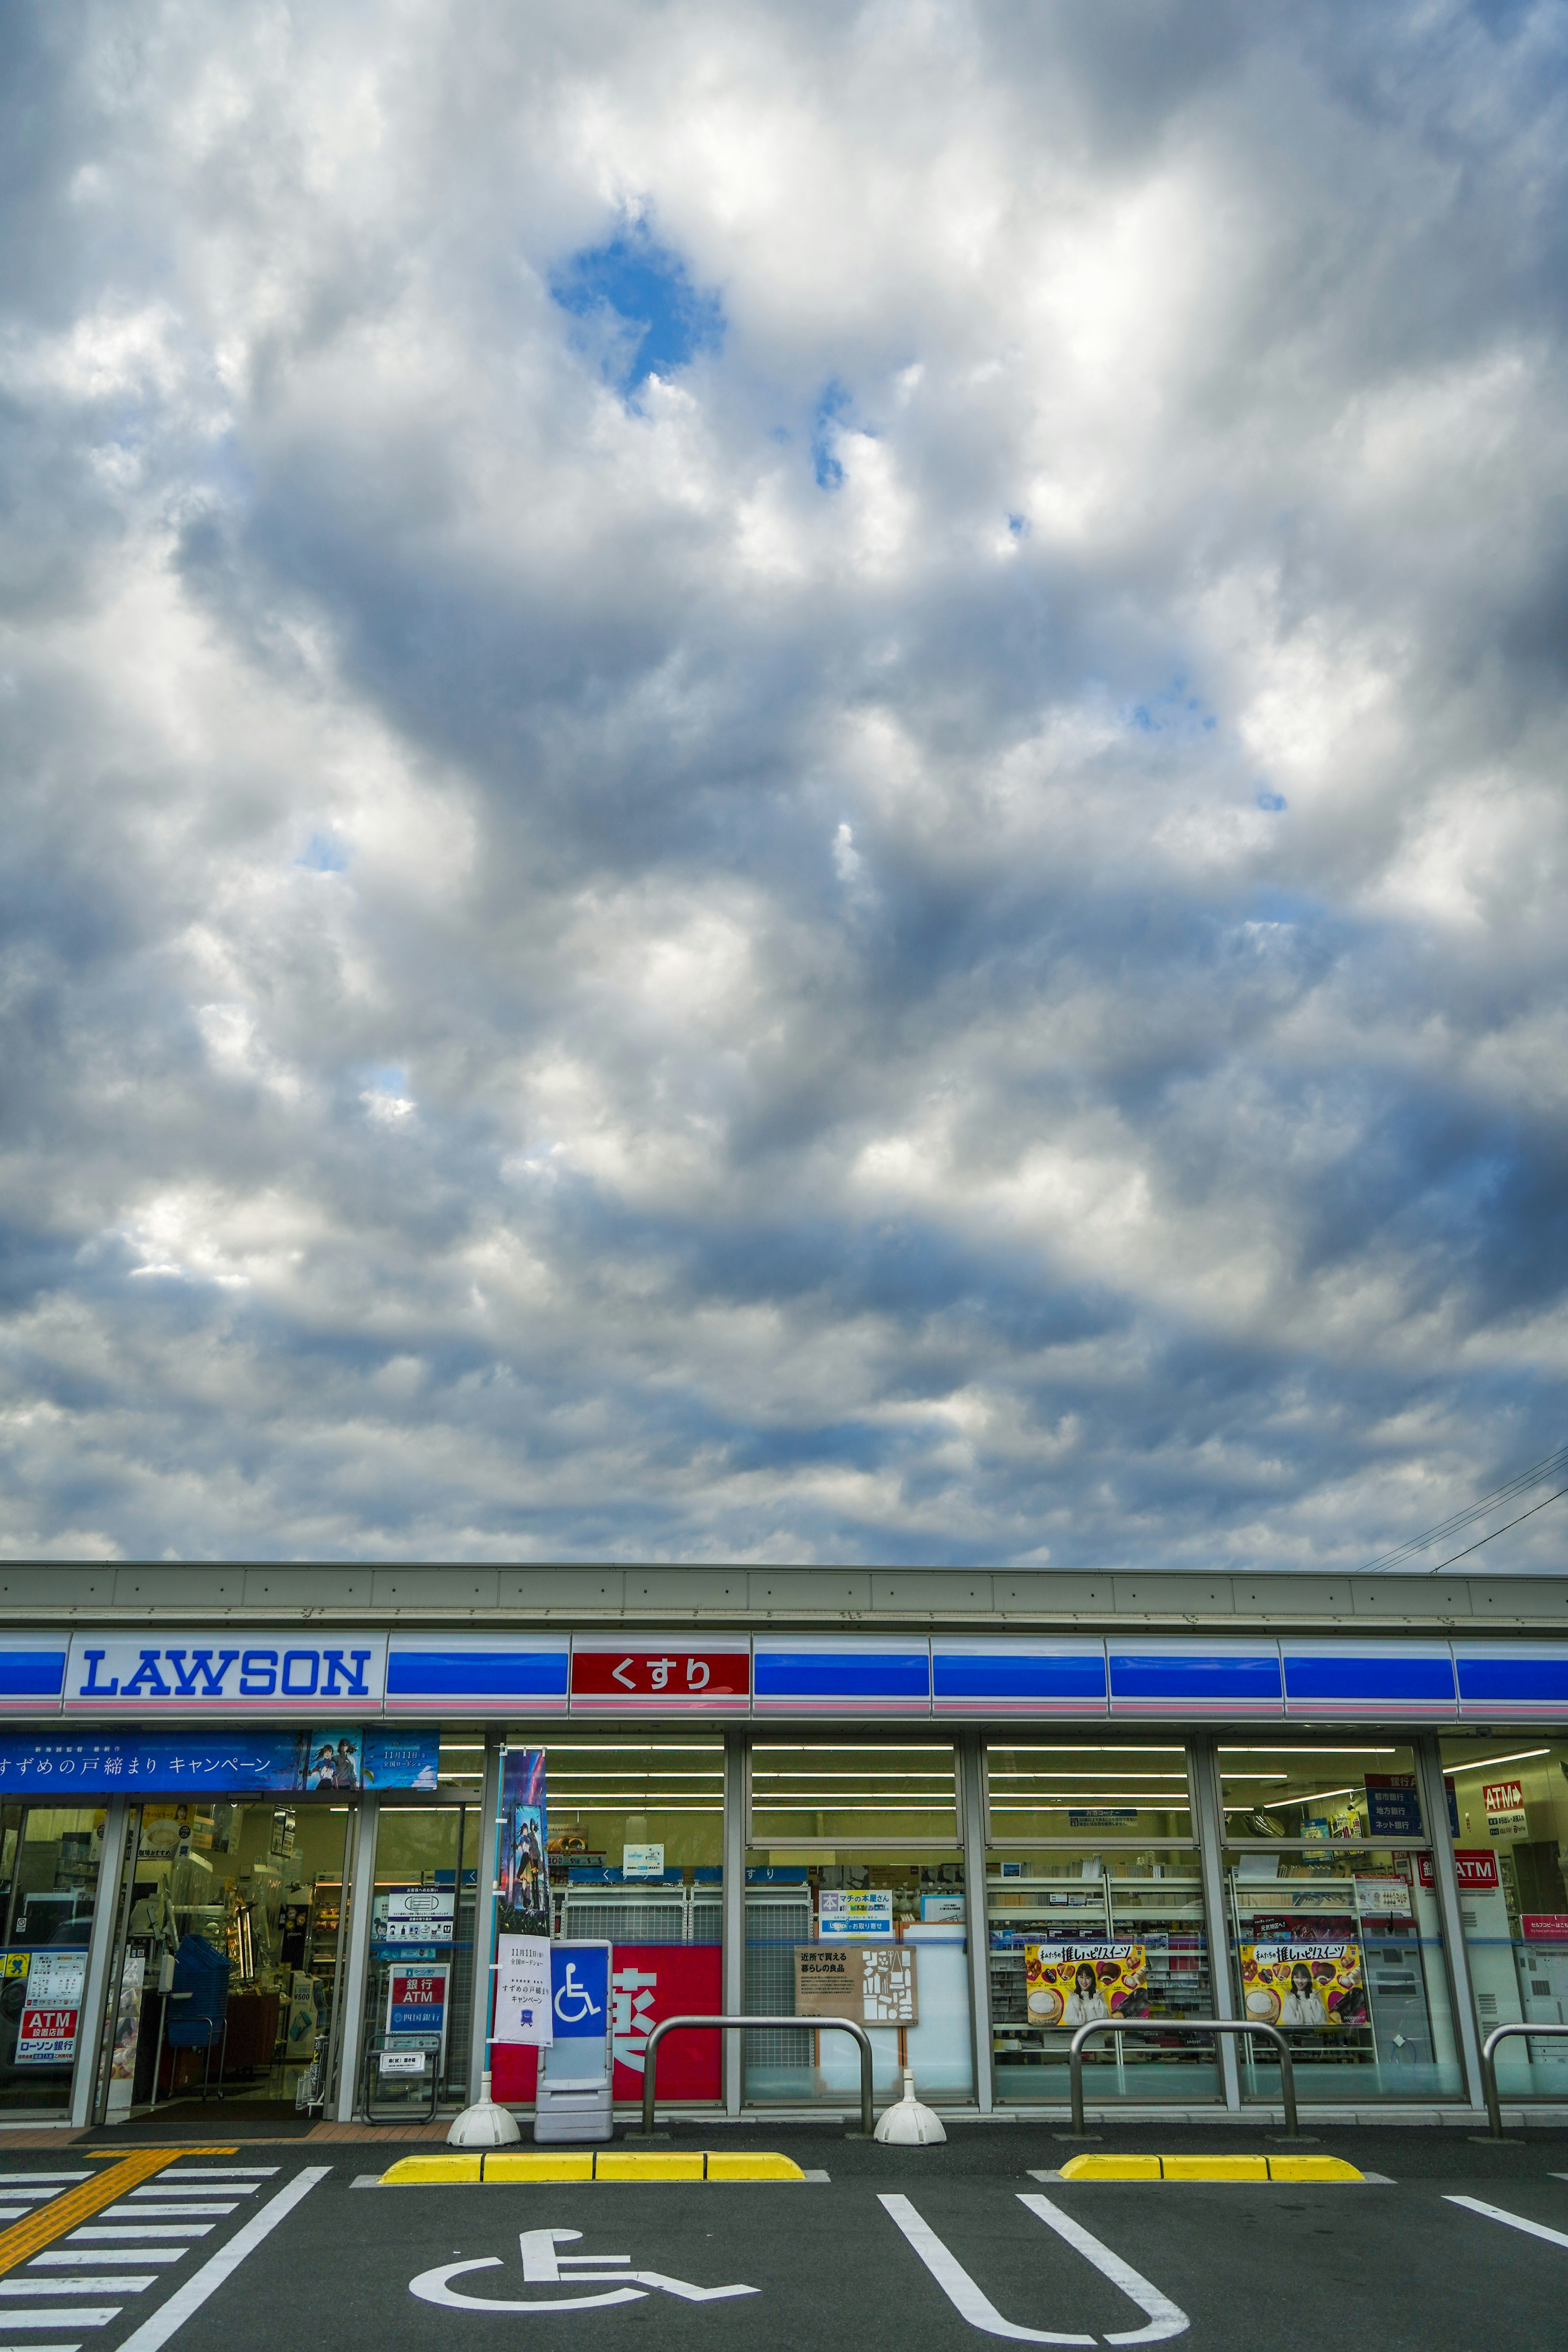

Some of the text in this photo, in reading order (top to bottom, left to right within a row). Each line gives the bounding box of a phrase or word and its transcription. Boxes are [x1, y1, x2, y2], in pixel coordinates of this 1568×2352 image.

[79, 1650, 371, 1695] LAWSON
[612, 1657, 710, 1690] くすり
[169, 1758, 271, 1773] キャンペーン
[1375, 1793, 1404, 1801] 都市銀行
[1487, 1785, 1513, 1810] ATM
[1376, 1807, 1406, 1815] 地方銀行
[1376, 1821, 1409, 1830] ネット銀行
[823, 1894, 889, 1910] 本 マチの本屋さん
[801, 1953, 846, 1961] 近所で買える
[801, 1964, 845, 1973] 暮らしの良品
[407, 1979, 432, 1989] 銀行
[502, 1985, 549, 1995] すずめの戸締まり
[403, 1992, 432, 2002] ATM
[28, 2013, 70, 2027] ATM
[404, 2013, 440, 2022] 四国銀行
[33, 2028, 65, 2037] 設置店舗
[20, 2041, 73, 2051] ローソン銀行
